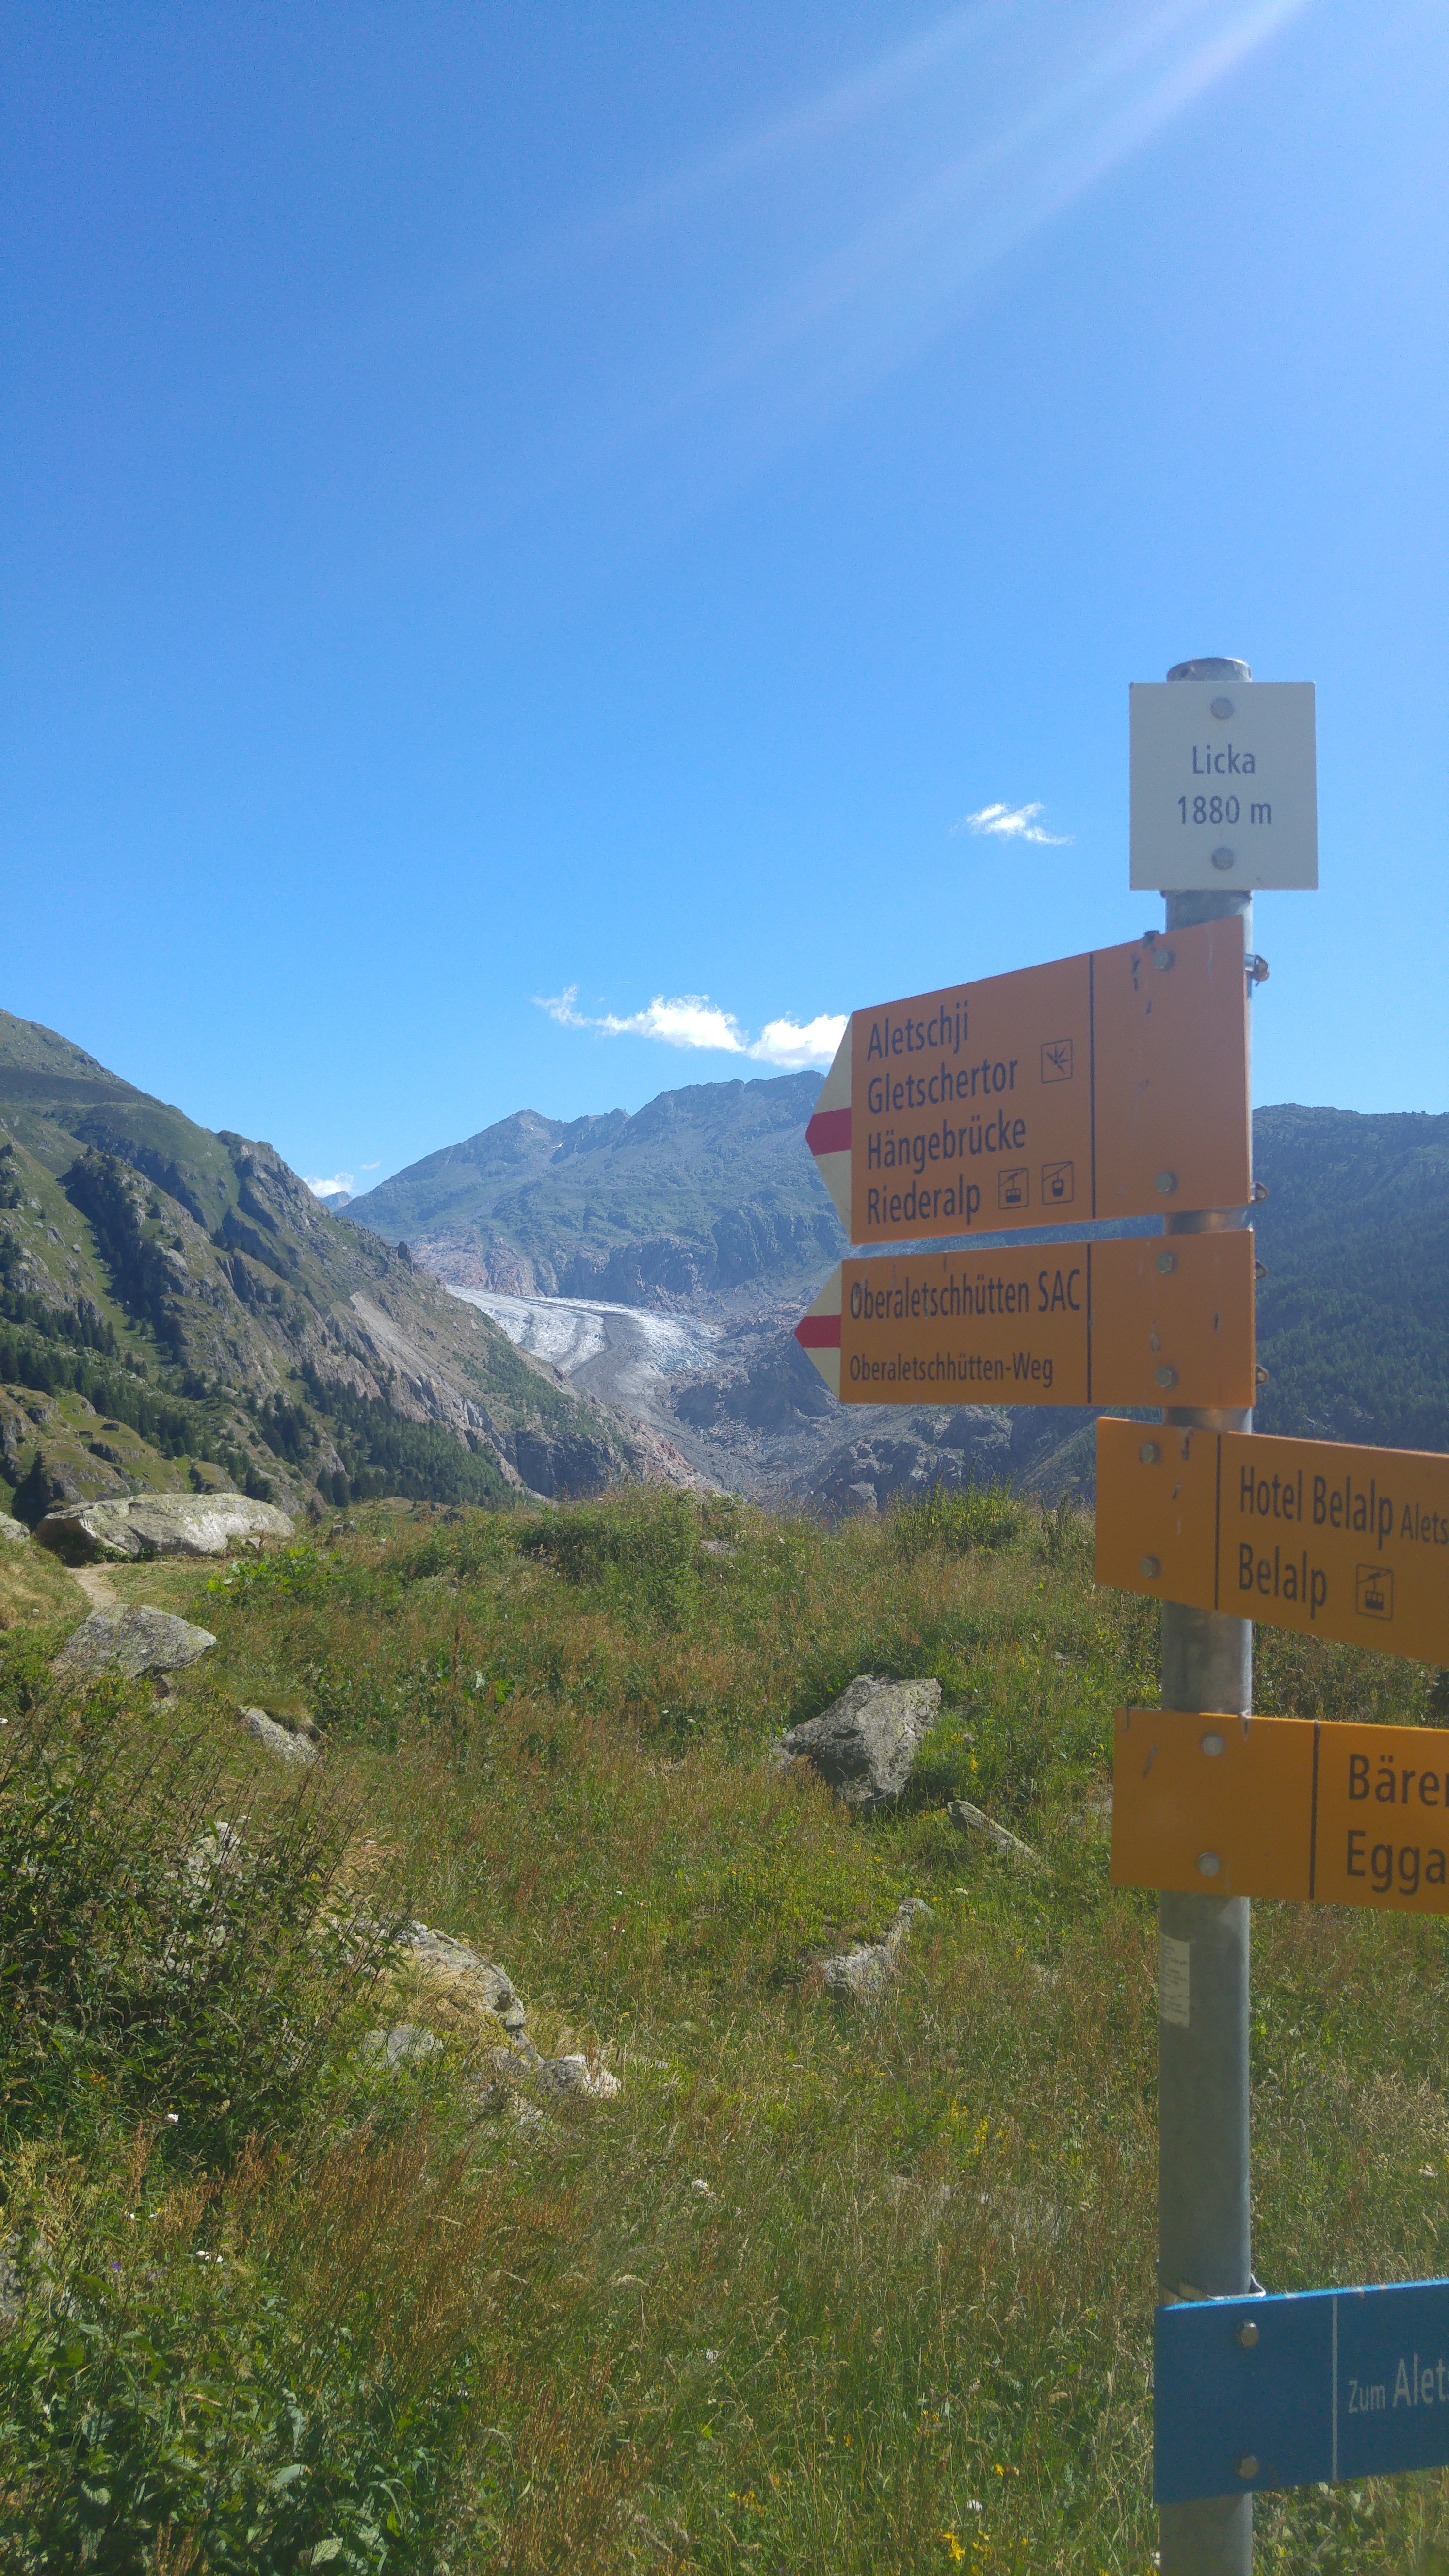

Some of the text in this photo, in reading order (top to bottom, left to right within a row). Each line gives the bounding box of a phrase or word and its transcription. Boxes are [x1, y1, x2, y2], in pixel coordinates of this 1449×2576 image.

[1192, 744, 1256, 775] Licka
[1178, 796, 1272, 825] 1880 m
[867, 1000, 968, 1061] Aletschji
[868, 1059, 1018, 1114] Gletschertor
[868, 1109, 1026, 1174] Hängebrücke
[868, 1173, 981, 1226] Riederalp
[850, 1268, 1081, 1319] Oberaletschhütten SAC
[850, 1352, 1054, 1389] Oberaletschhütten-Weg
[1240, 1465, 1449, 1550] Hotel Belalp Alets
[1239, 1542, 1327, 1620] Belalp
[1348, 1753, 1449, 1807] Bäre
[1347, 1829, 1446, 1895] Egga
[1347, 2351, 1449, 2413] Zum Alet
